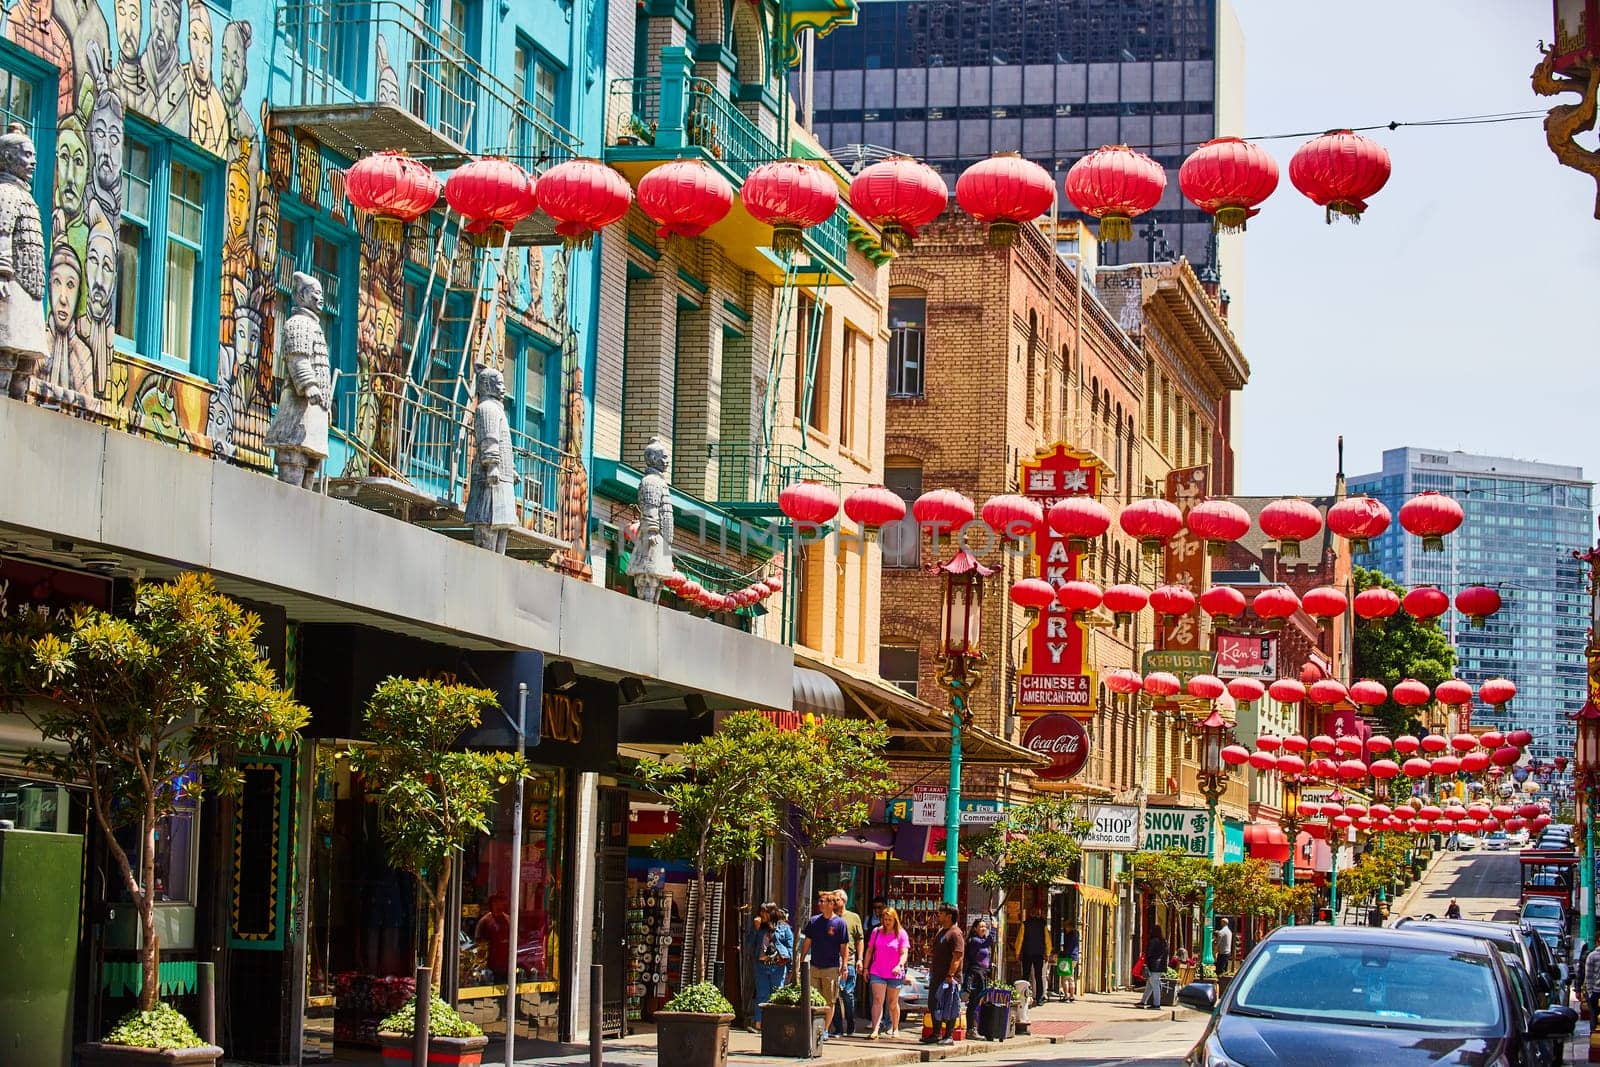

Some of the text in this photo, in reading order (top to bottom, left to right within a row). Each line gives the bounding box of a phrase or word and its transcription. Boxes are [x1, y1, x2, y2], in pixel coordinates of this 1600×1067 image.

[1047, 526, 1069, 663] AKERY
[1222, 639, 1259, 663] Kan's
[1022, 676, 1088, 689] CHINESE &
[1022, 691, 1088, 703] AMERICAN FOOD
[963, 814, 1006, 822] Commercial
[1095, 818, 1132, 834] SHOP
[1145, 813, 1185, 831] SNOW
[1141, 834, 1189, 851] ARDEN
